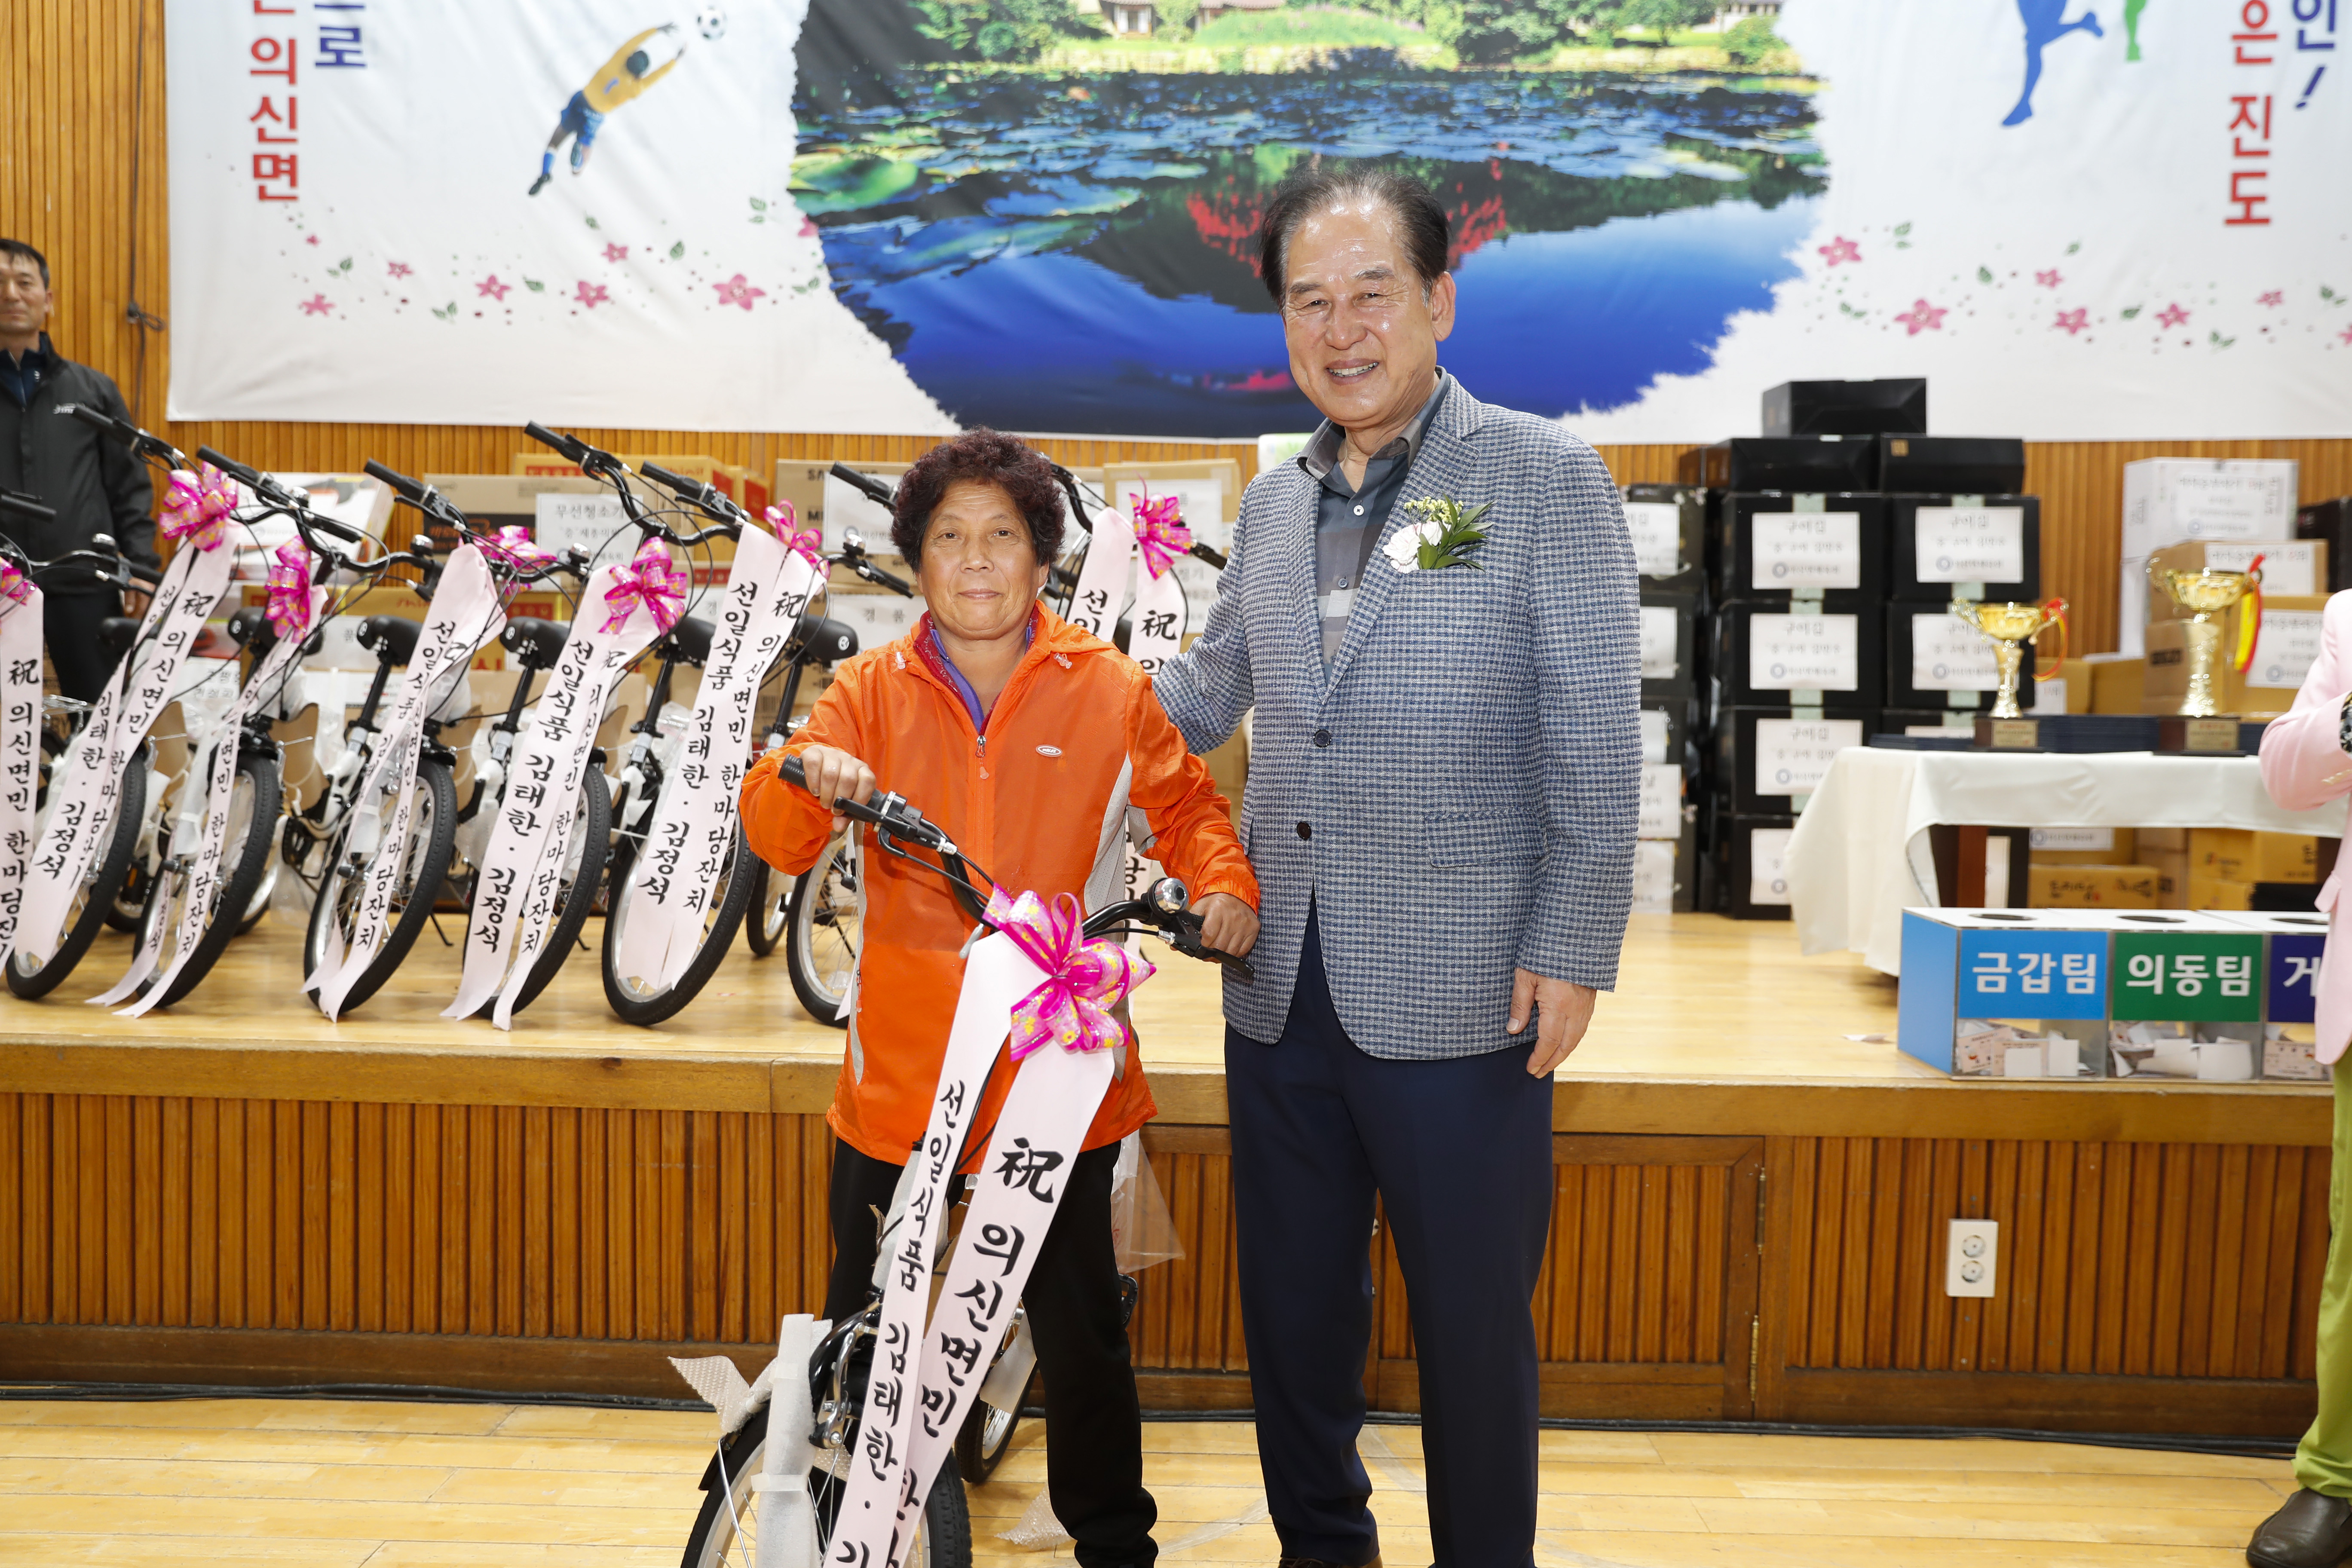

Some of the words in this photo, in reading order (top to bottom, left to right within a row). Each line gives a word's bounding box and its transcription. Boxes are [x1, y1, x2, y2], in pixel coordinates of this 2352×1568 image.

[250, 37, 299, 202] 의신면
[2224, 95, 2271, 226] 진도
[180, 591, 214, 618] 祝
[708, 582, 758, 691] 선일식품
[771, 591, 806, 619] 祝
[1140, 610, 1178, 640] 祝
[7, 658, 40, 686] 祝
[129, 631, 187, 734] 의신면민
[398, 620, 456, 720] 선일식품
[538, 640, 594, 741] 선일식품
[728, 634, 781, 743] 의신면민
[7, 701, 33, 812] 의신면민
[82, 691, 106, 770] 김태한
[682, 706, 714, 790] 김태한
[34, 801, 86, 880] 김정석
[507, 754, 555, 836] 김태한
[683, 764, 741, 916] 한마당잔치
[178, 813, 226, 955] 한마당잔치
[356, 806, 409, 951] 한마당잔치
[474, 867, 517, 954] 김정석
[522, 811, 571, 954] 한마당잔치
[638, 821, 690, 905] 김정석
[1972, 951, 2097, 995] 금갑팀
[2126, 954, 2252, 998] 의동팀
[898, 1079, 965, 1292] 선일식품
[993, 1137, 1064, 1203] 祝
[921, 1223, 1026, 1438] 의신면민
[865, 1321, 910, 1482] 김태한
